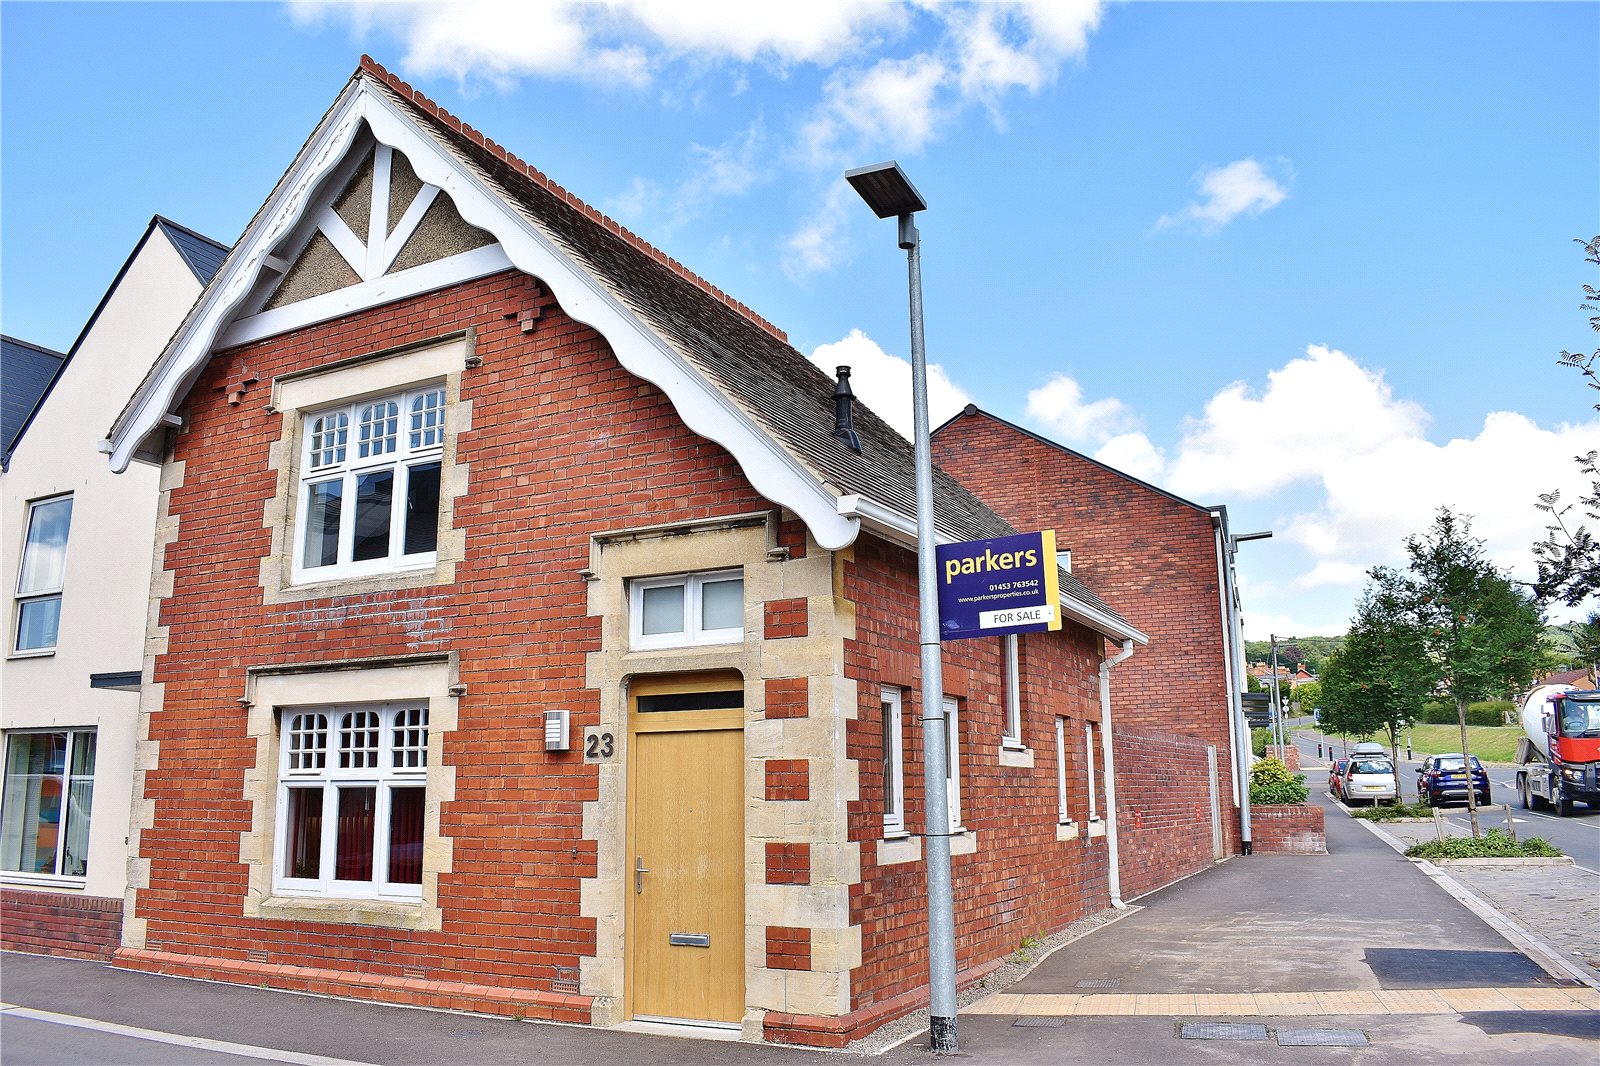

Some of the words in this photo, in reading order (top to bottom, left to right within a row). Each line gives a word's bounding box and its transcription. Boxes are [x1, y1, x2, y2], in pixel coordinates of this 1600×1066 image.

[945, 548, 1037, 584] parkers
[989, 582, 1011, 592] 01453
[1012, 579, 1039, 589] 763542
[958, 589, 1039, 603] www.parkersproperties.co.uk
[993, 612, 1014, 624] FOR
[1016, 609, 1041, 622] SALE
[586, 732, 614, 758] 23
